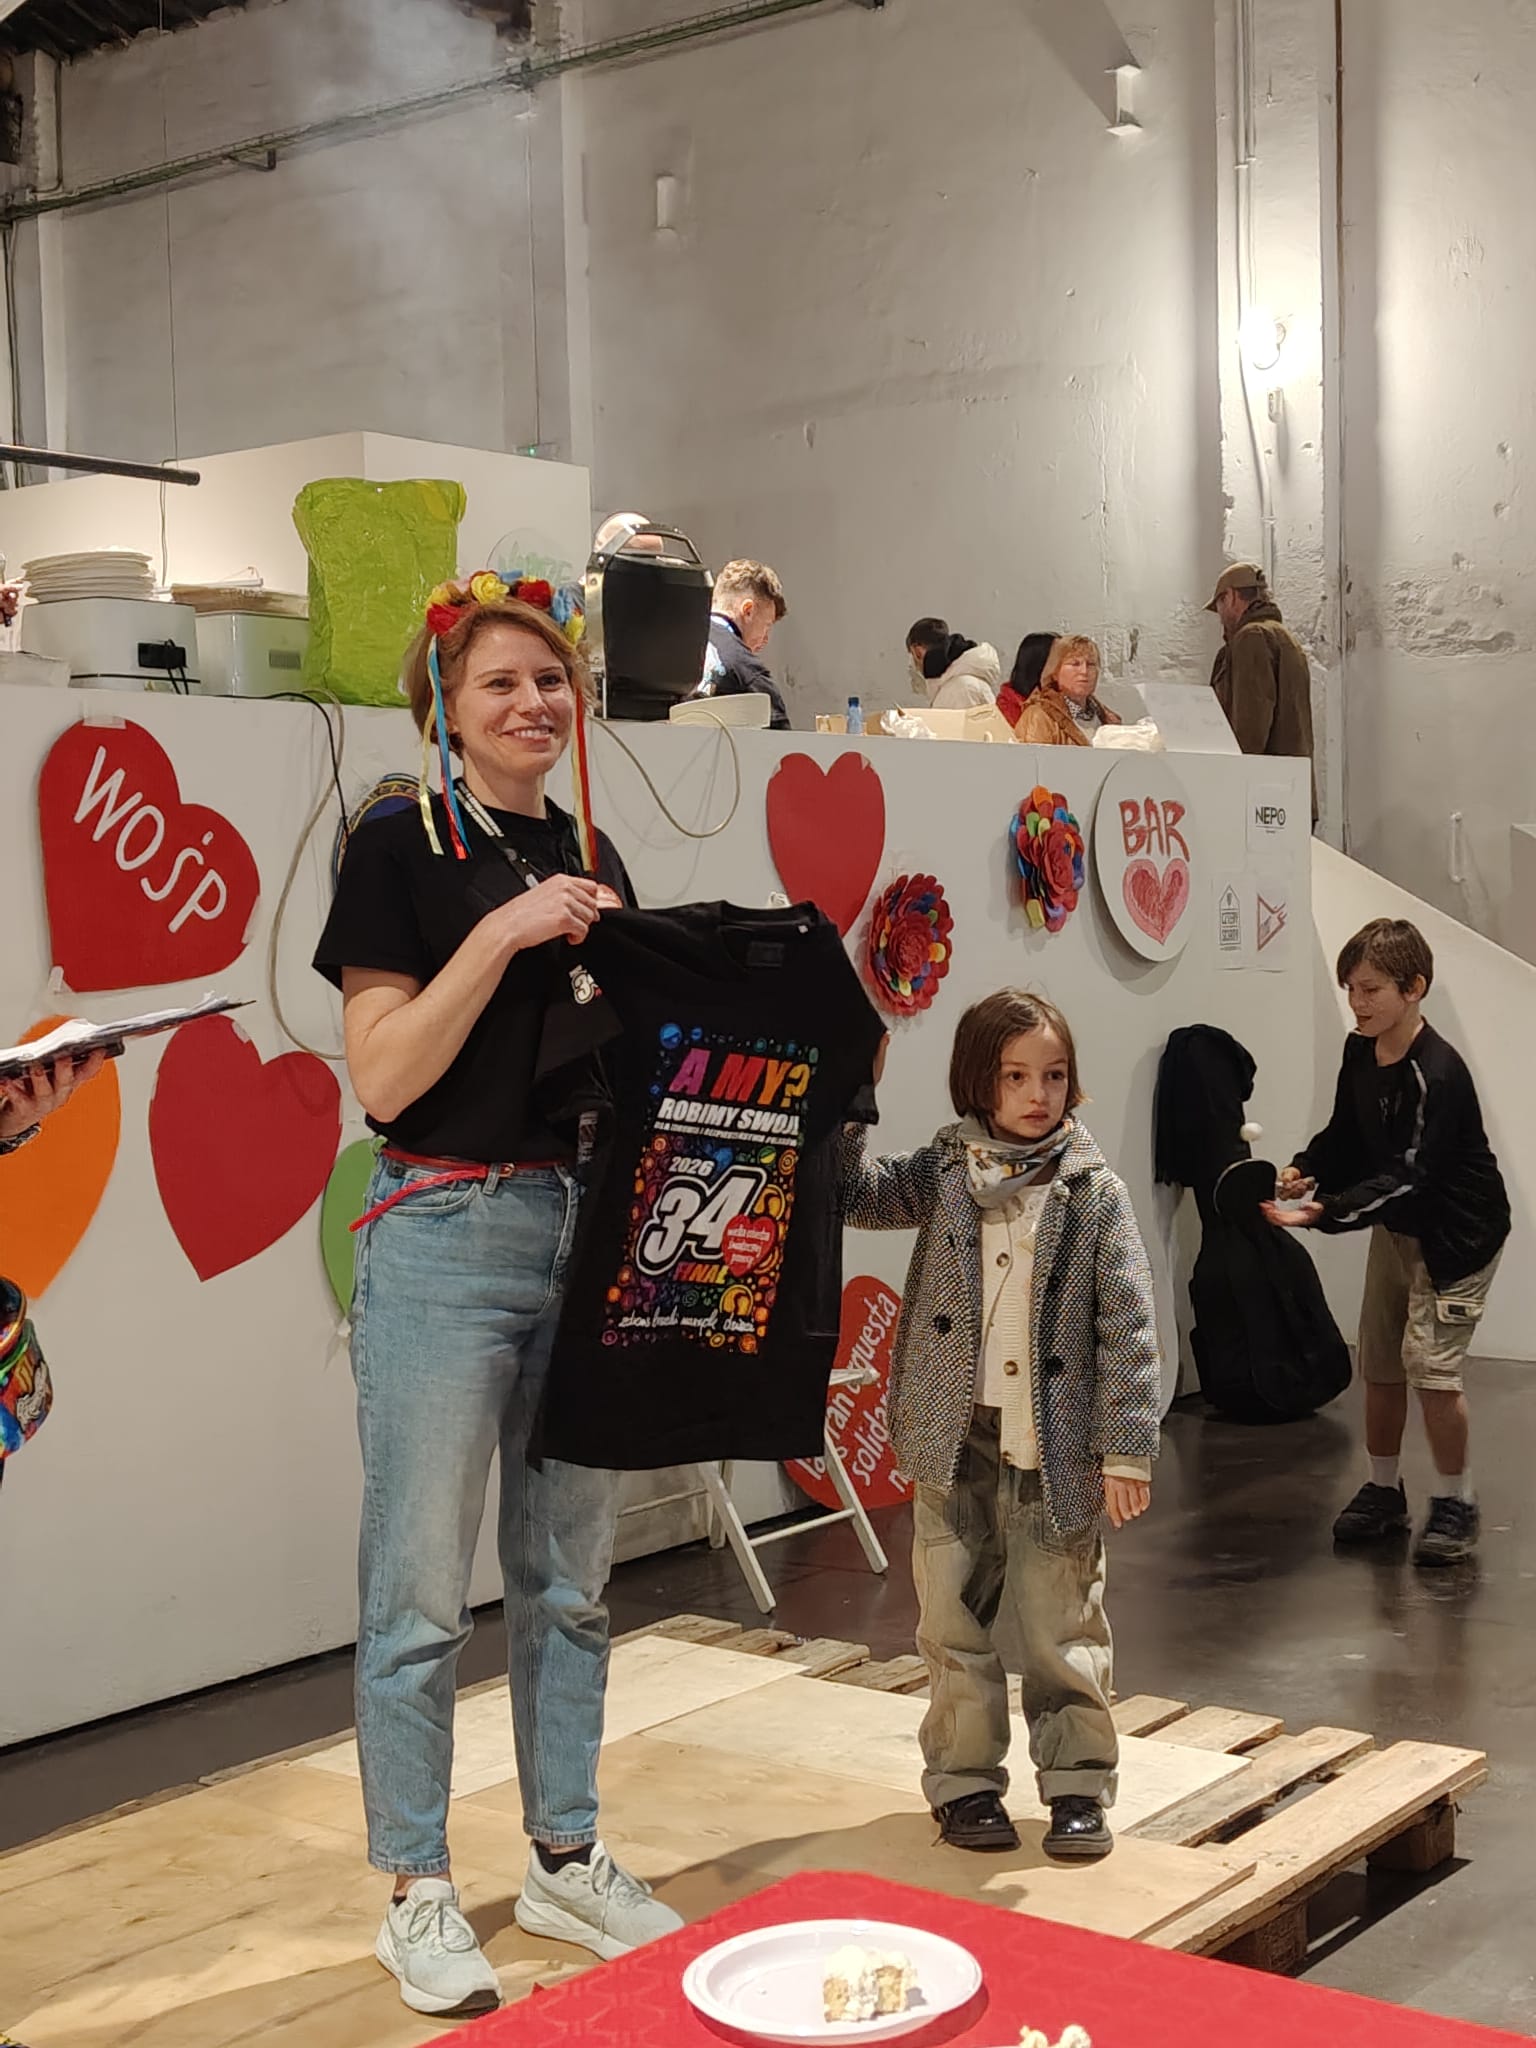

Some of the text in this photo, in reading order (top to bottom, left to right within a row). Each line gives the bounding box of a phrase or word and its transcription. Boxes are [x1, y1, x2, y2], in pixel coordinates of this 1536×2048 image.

[1119, 796, 1190, 862] BAR
[1255, 806, 1286, 826] NEPO
[668, 1048, 813, 1109] A MY?
[657, 1097, 741, 1129] ROBIMY
[668, 1155, 715, 1177] 2026
[638, 1168, 764, 1272] 34
